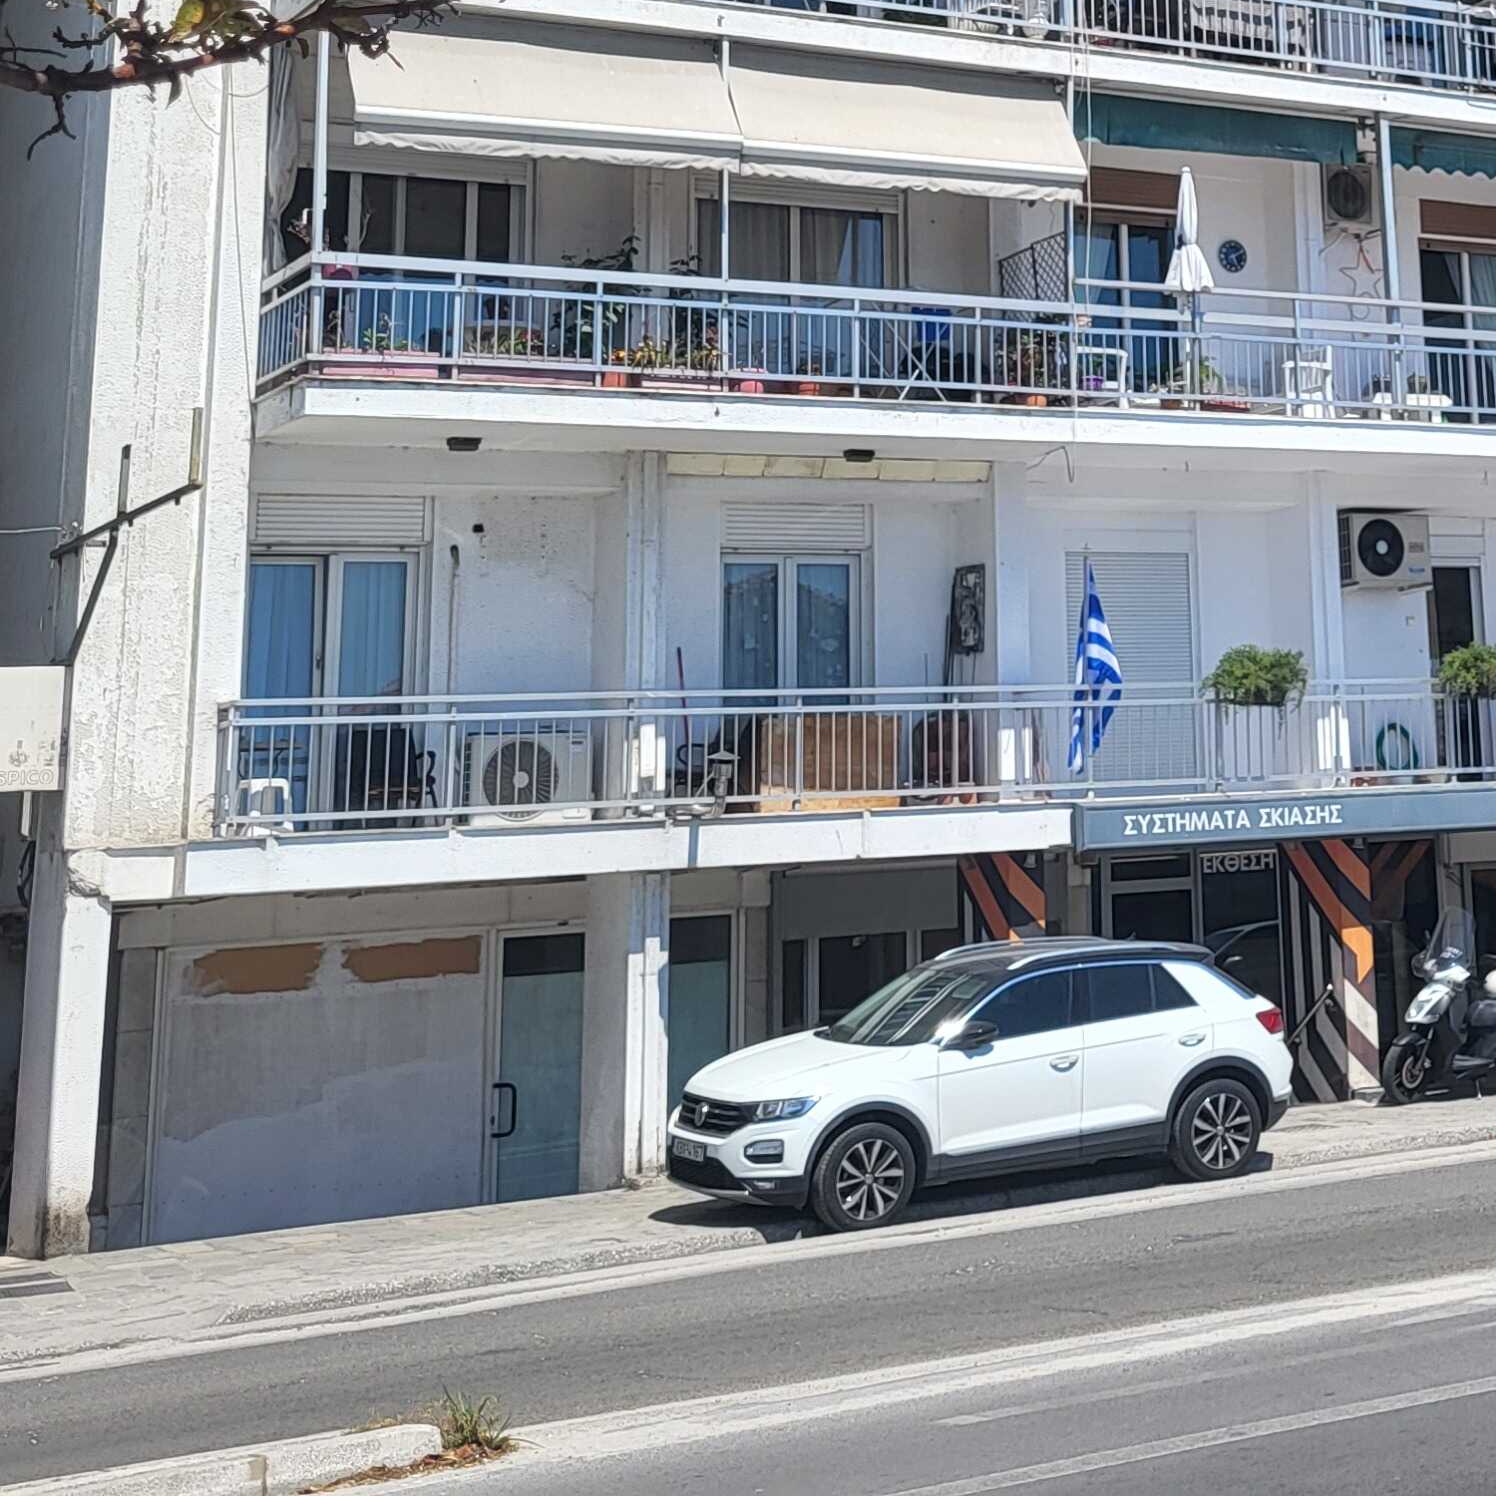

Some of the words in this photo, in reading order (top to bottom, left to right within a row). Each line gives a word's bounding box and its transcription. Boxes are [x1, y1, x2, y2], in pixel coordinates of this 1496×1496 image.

[1123, 809, 1251, 836] ΣΥΣΤΗΜΑΤΑ
[1259, 804, 1343, 828] ΣΚΙΑΣΗΣ
[1203, 853, 1274, 874] ΕΚΘΕΣΗ
